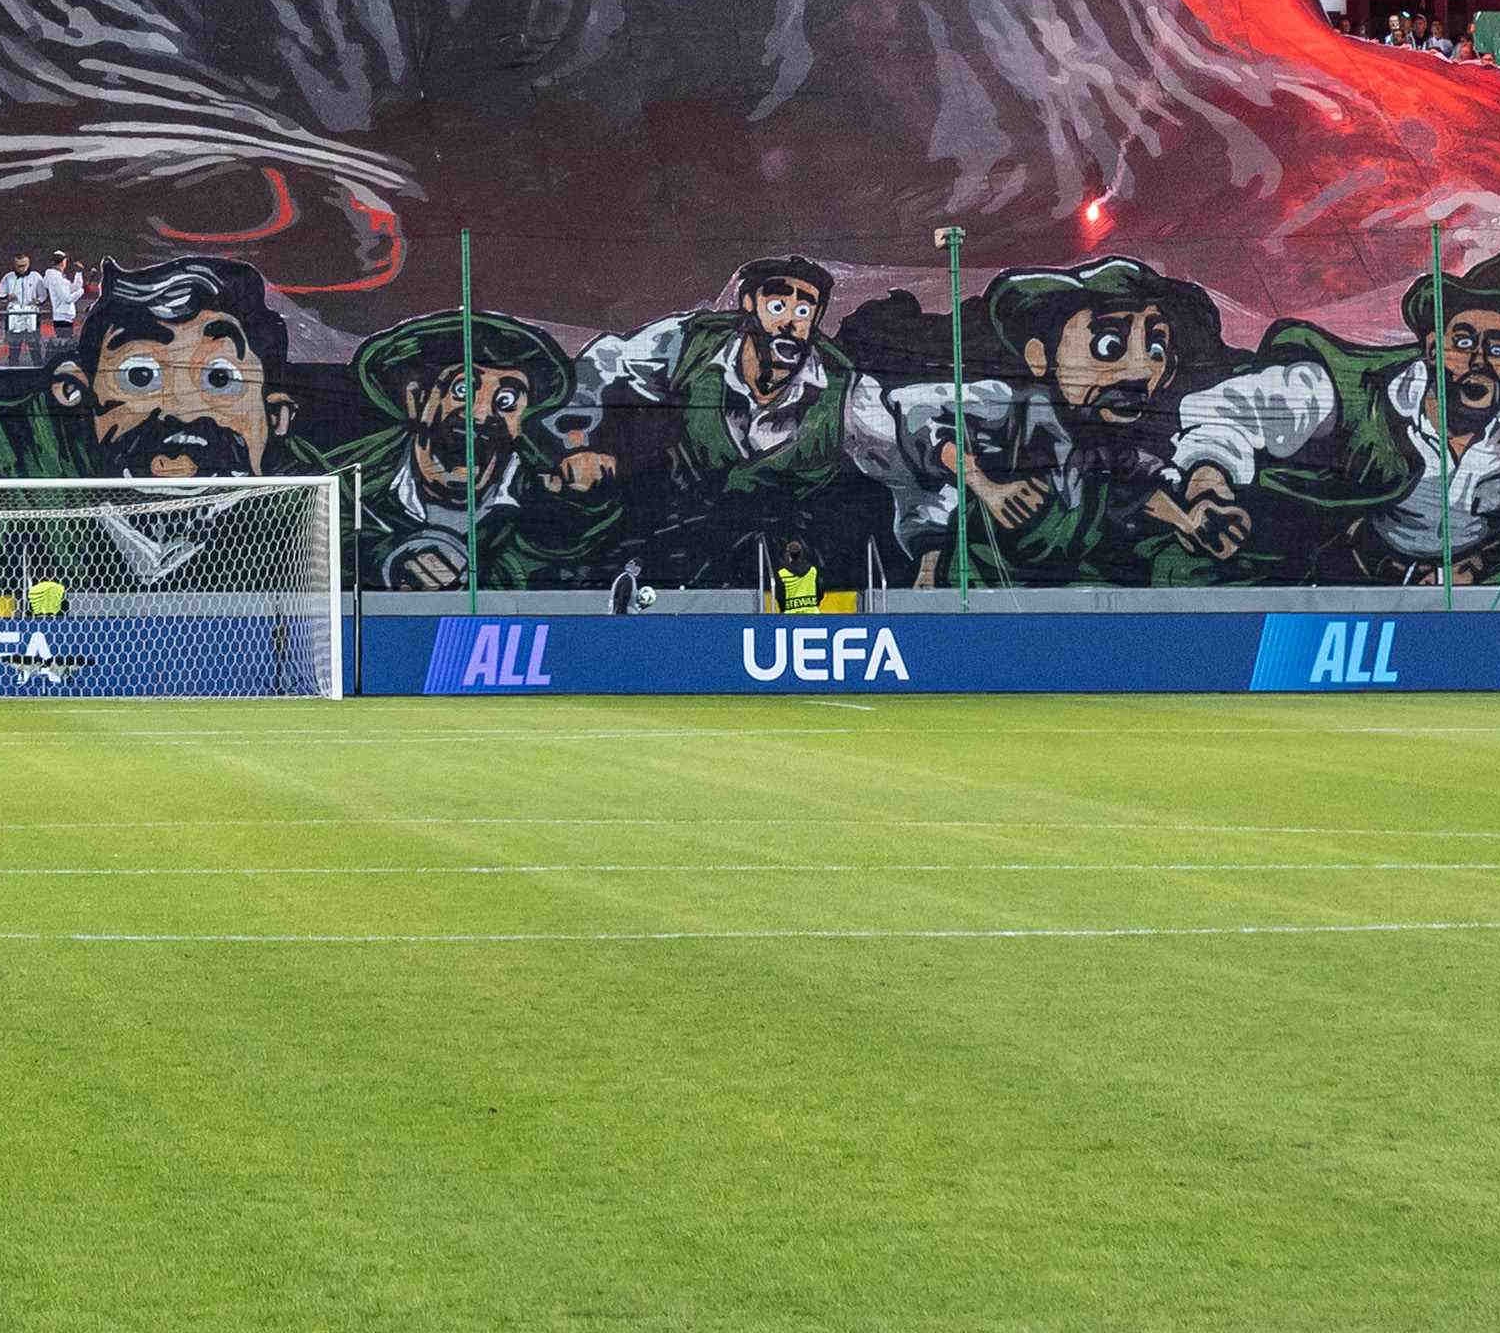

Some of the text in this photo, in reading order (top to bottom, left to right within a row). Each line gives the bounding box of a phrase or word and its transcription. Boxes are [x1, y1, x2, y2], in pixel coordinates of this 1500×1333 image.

[462, 624, 551, 686] ALL
[743, 627, 910, 681] UEFA
[1309, 621, 1398, 683] ALL
